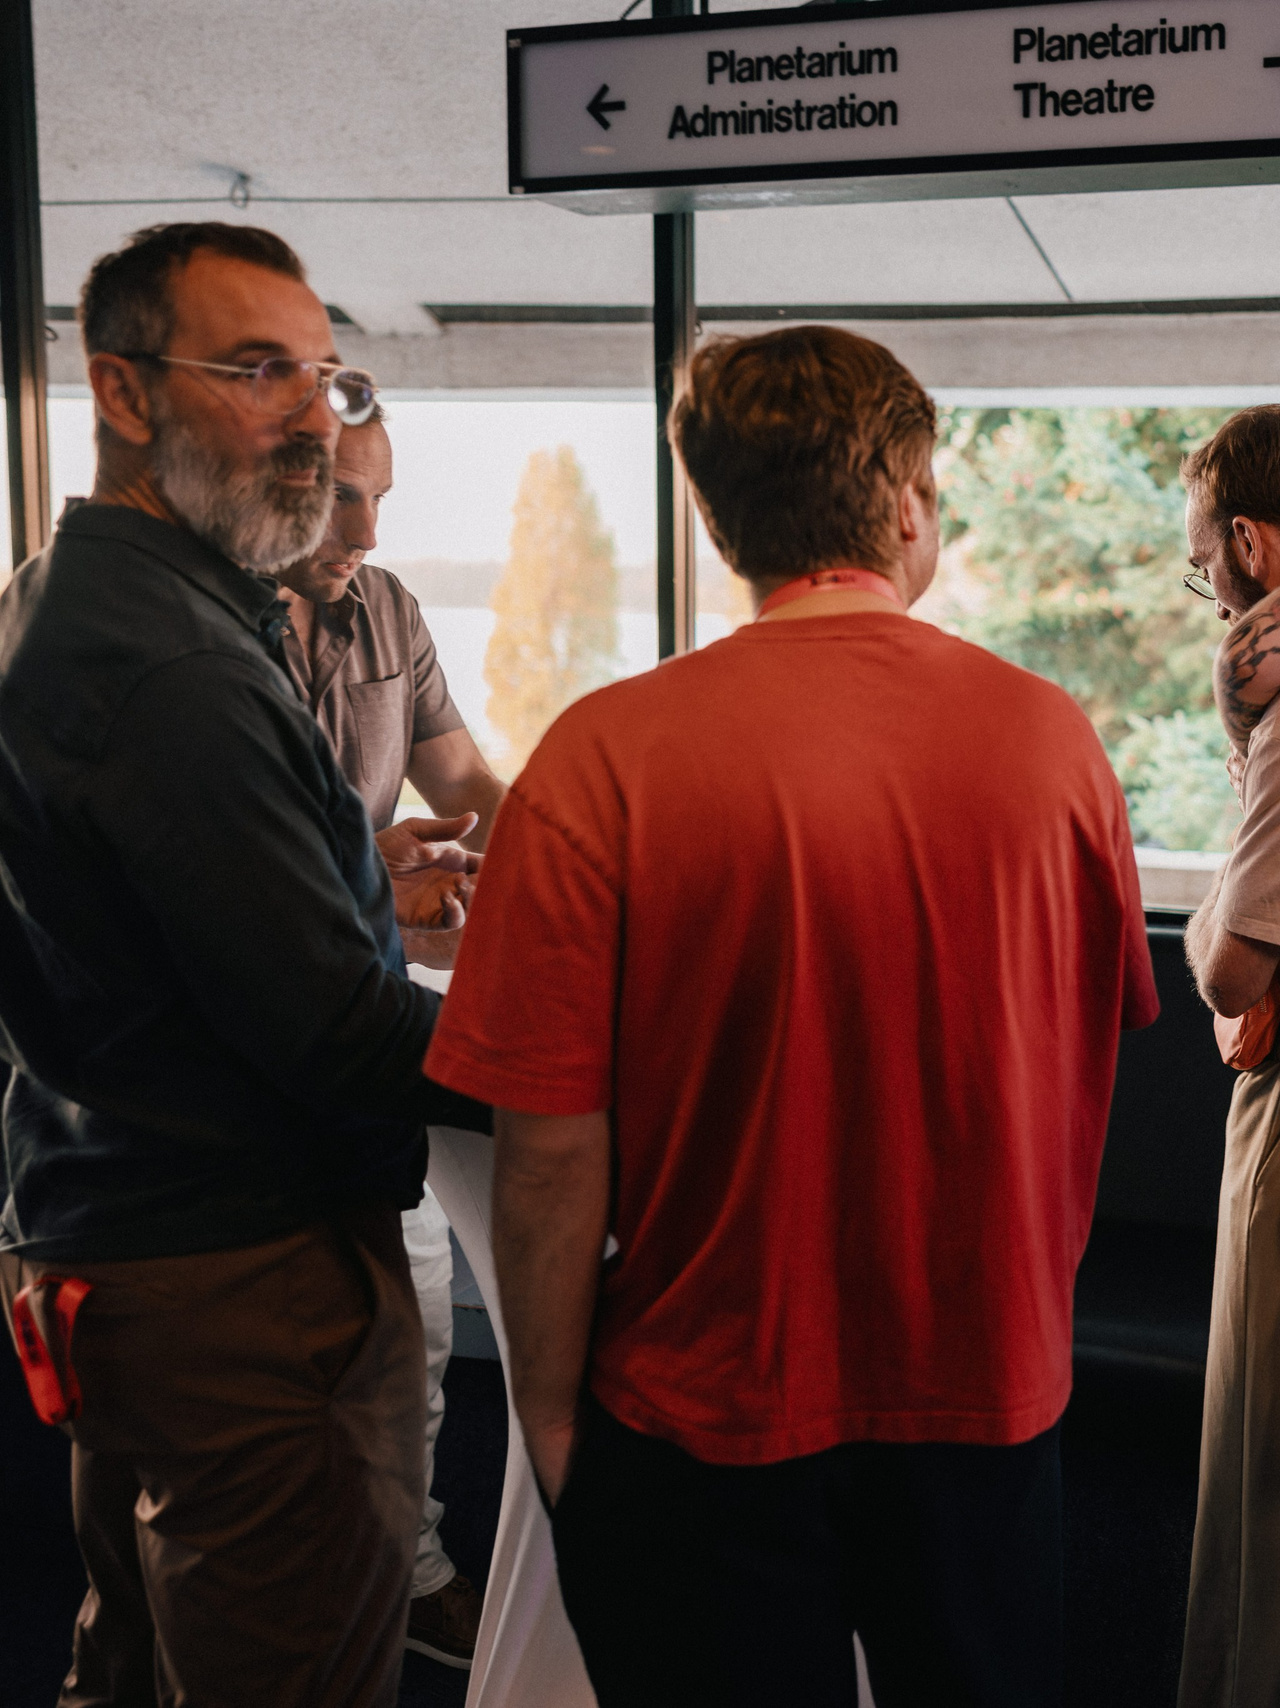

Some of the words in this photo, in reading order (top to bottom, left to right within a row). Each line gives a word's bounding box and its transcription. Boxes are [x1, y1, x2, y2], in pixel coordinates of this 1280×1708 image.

[705, 41, 898, 86] Planetarium
[1013, 19, 1227, 65] Planetarium
[667, 93, 898, 141] Administration
[1013, 79, 1156, 119] Theatre
